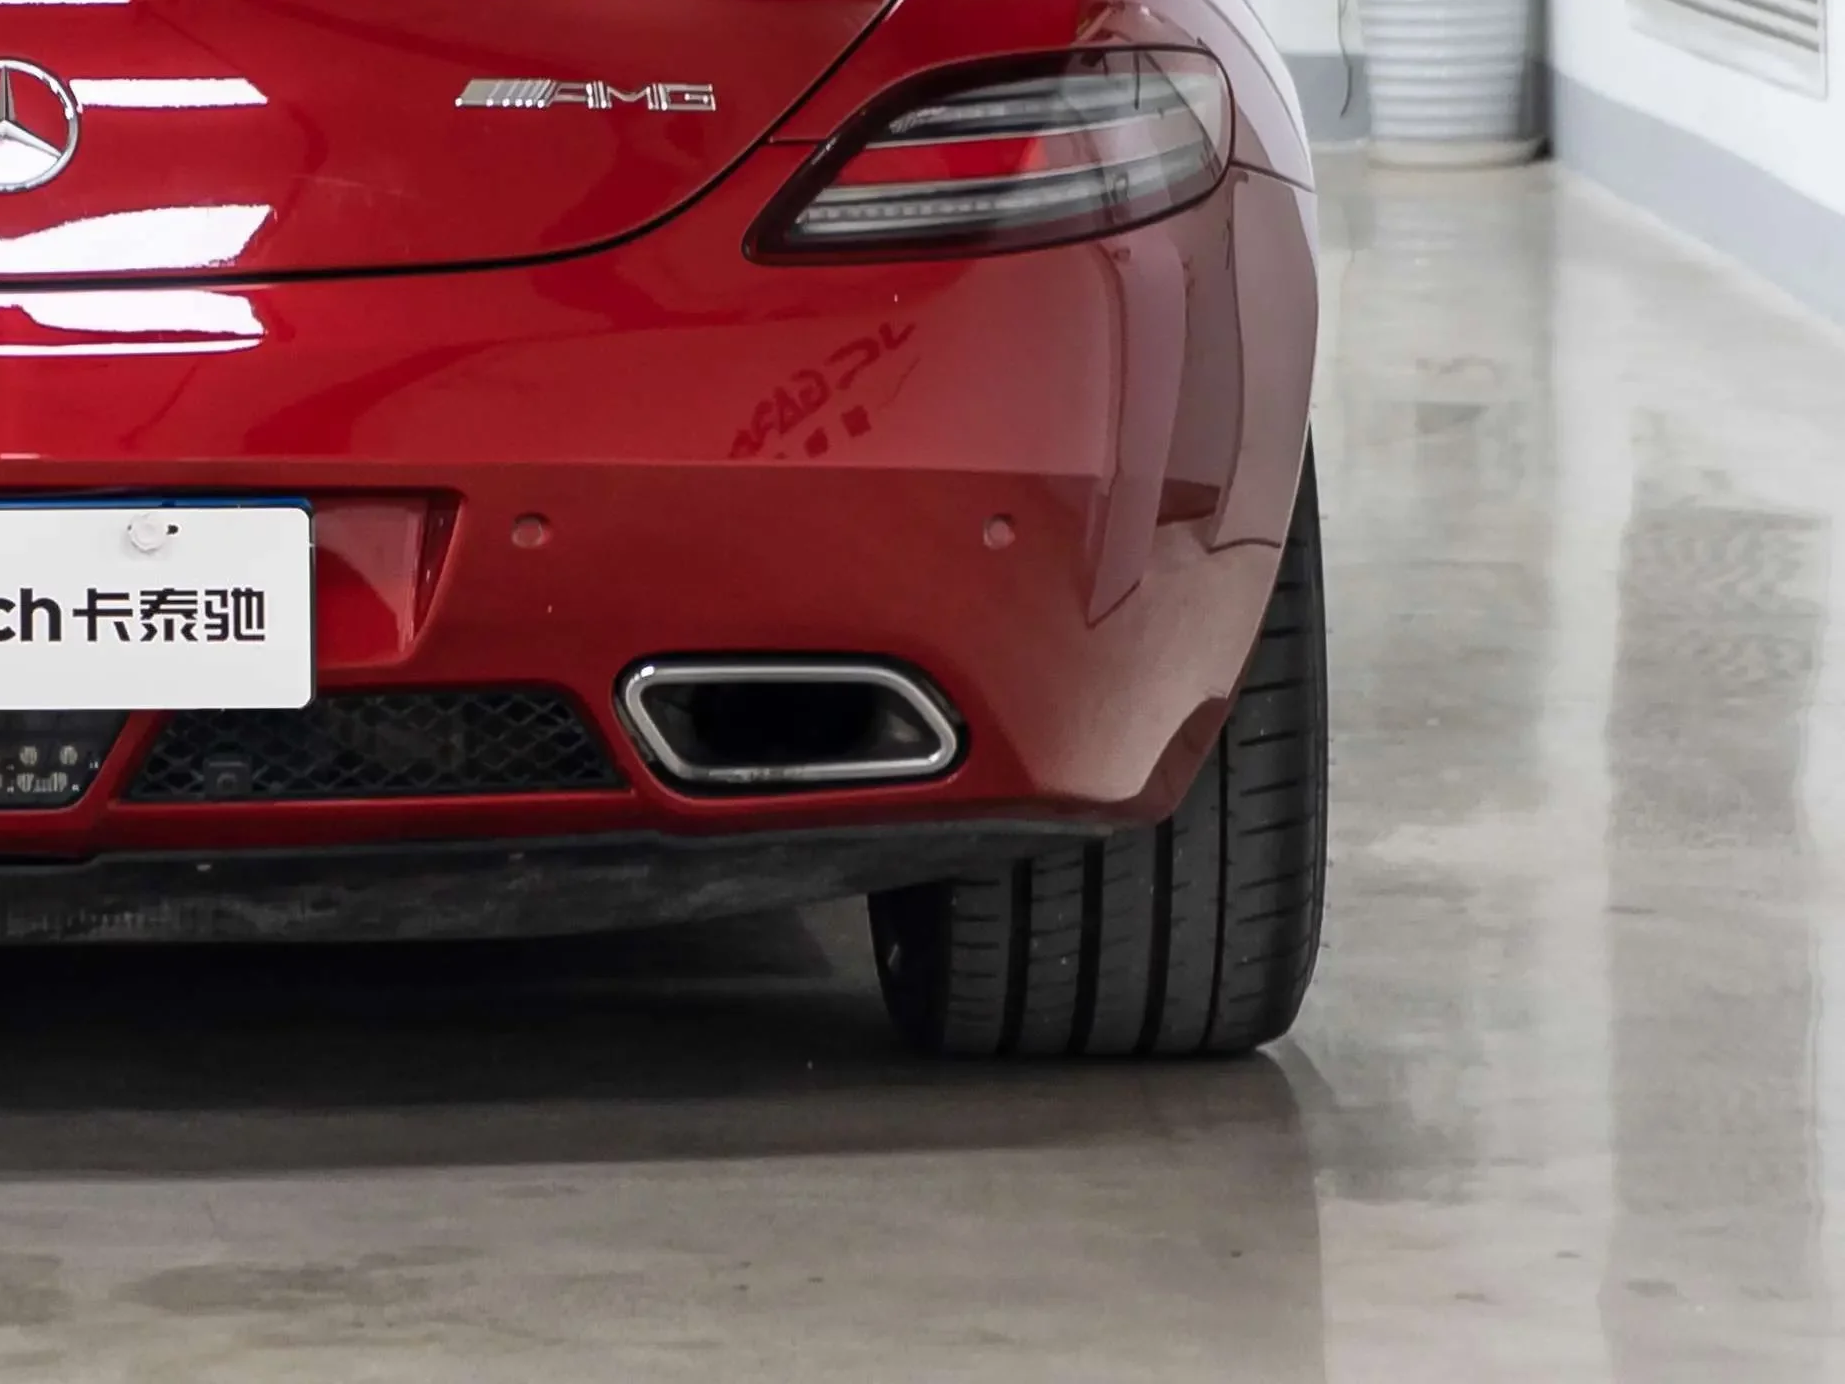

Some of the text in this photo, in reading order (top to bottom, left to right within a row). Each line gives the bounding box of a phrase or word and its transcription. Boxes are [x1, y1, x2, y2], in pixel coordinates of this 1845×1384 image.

[540, 79, 716, 112] AMG
[73, 587, 266, 643] 卡泰驰
